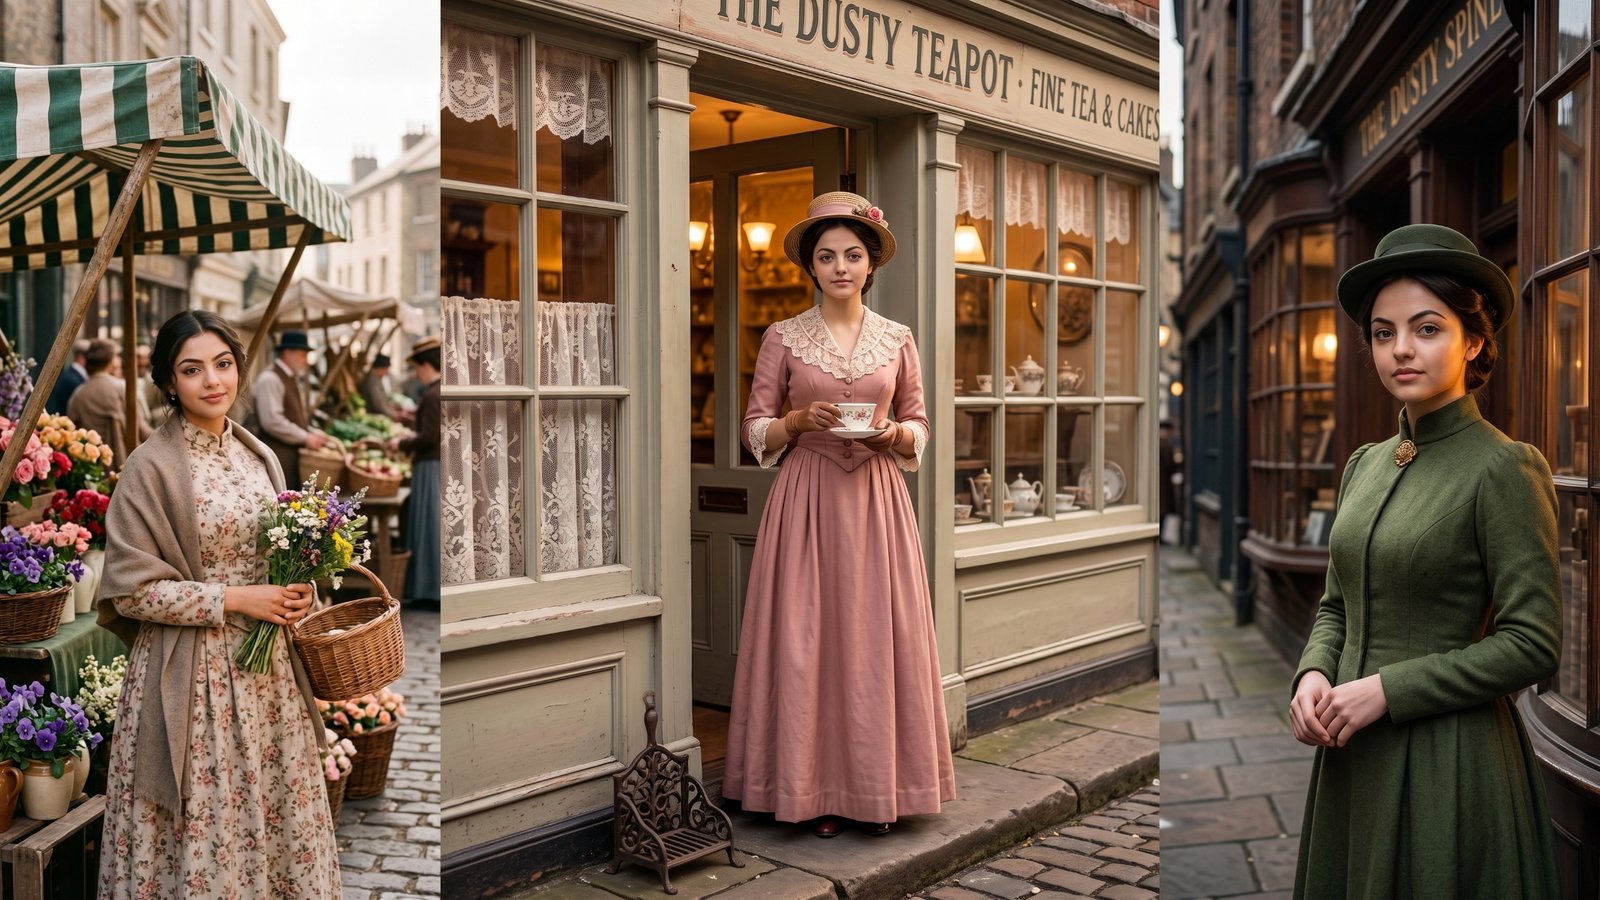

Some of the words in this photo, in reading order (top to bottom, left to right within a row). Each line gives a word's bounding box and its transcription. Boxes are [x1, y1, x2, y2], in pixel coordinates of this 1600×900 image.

[796, 0, 902, 68] DUSTY
[911, 24, 1014, 102] TEAPOT
[1029, 67, 1066, 114] FINE
[1071, 81, 1098, 124] TEA
[1102, 94, 1113, 128] &
[1117, 97, 1160, 142] CAKES
[1358, 101, 1387, 158] THE
[1389, 37, 1440, 128] DUSTY
